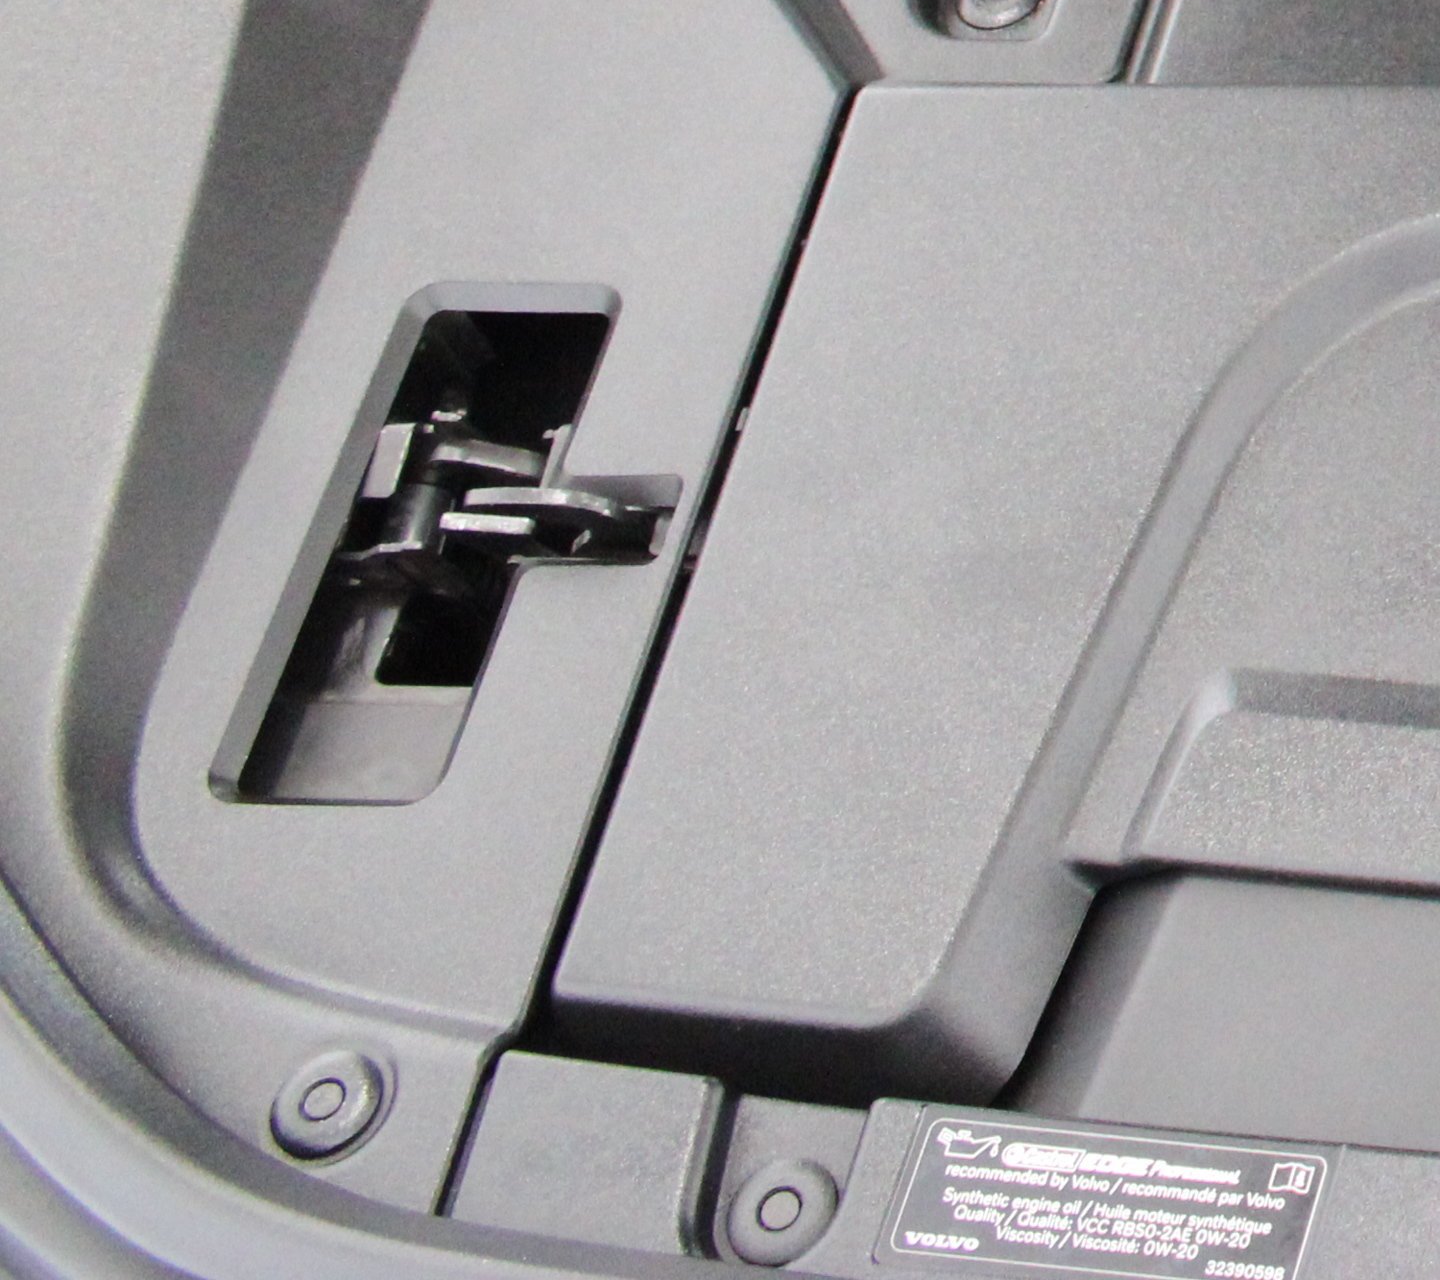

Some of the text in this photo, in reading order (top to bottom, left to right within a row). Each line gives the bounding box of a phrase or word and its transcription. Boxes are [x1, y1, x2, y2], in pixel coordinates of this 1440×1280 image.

[945, 1164, 1048, 1187] recommended
[1050, 1171, 1069, 1190] by
[1072, 1174, 1110, 1193] Volvo
[1122, 1181, 1216, 1202] recommandé
[1217, 1192, 1243, 1207] par
[1247, 1191, 1286, 1211] Volvo
[942, 1186, 1010, 1209] Synthetic
[1011, 1196, 1061, 1214] engine
[1062, 1200, 1082, 1215] oil
[1093, 1203, 1132, 1221] Huile
[1133, 1209, 1188, 1226] moteur
[1187, 1213, 1273, 1237] synthétique
[953, 1204, 1005, 1227] Quality
[1017, 1212, 1074, 1232] Qualité:
[1076, 1217, 1110, 1235] VCC
[904, 1230, 980, 1252] VOLVO
[996, 1225, 1060, 1250] Viscosity
[1072, 1234, 1141, 1255] Viscosité:
[1205, 1260, 1287, 1280] 32390598
